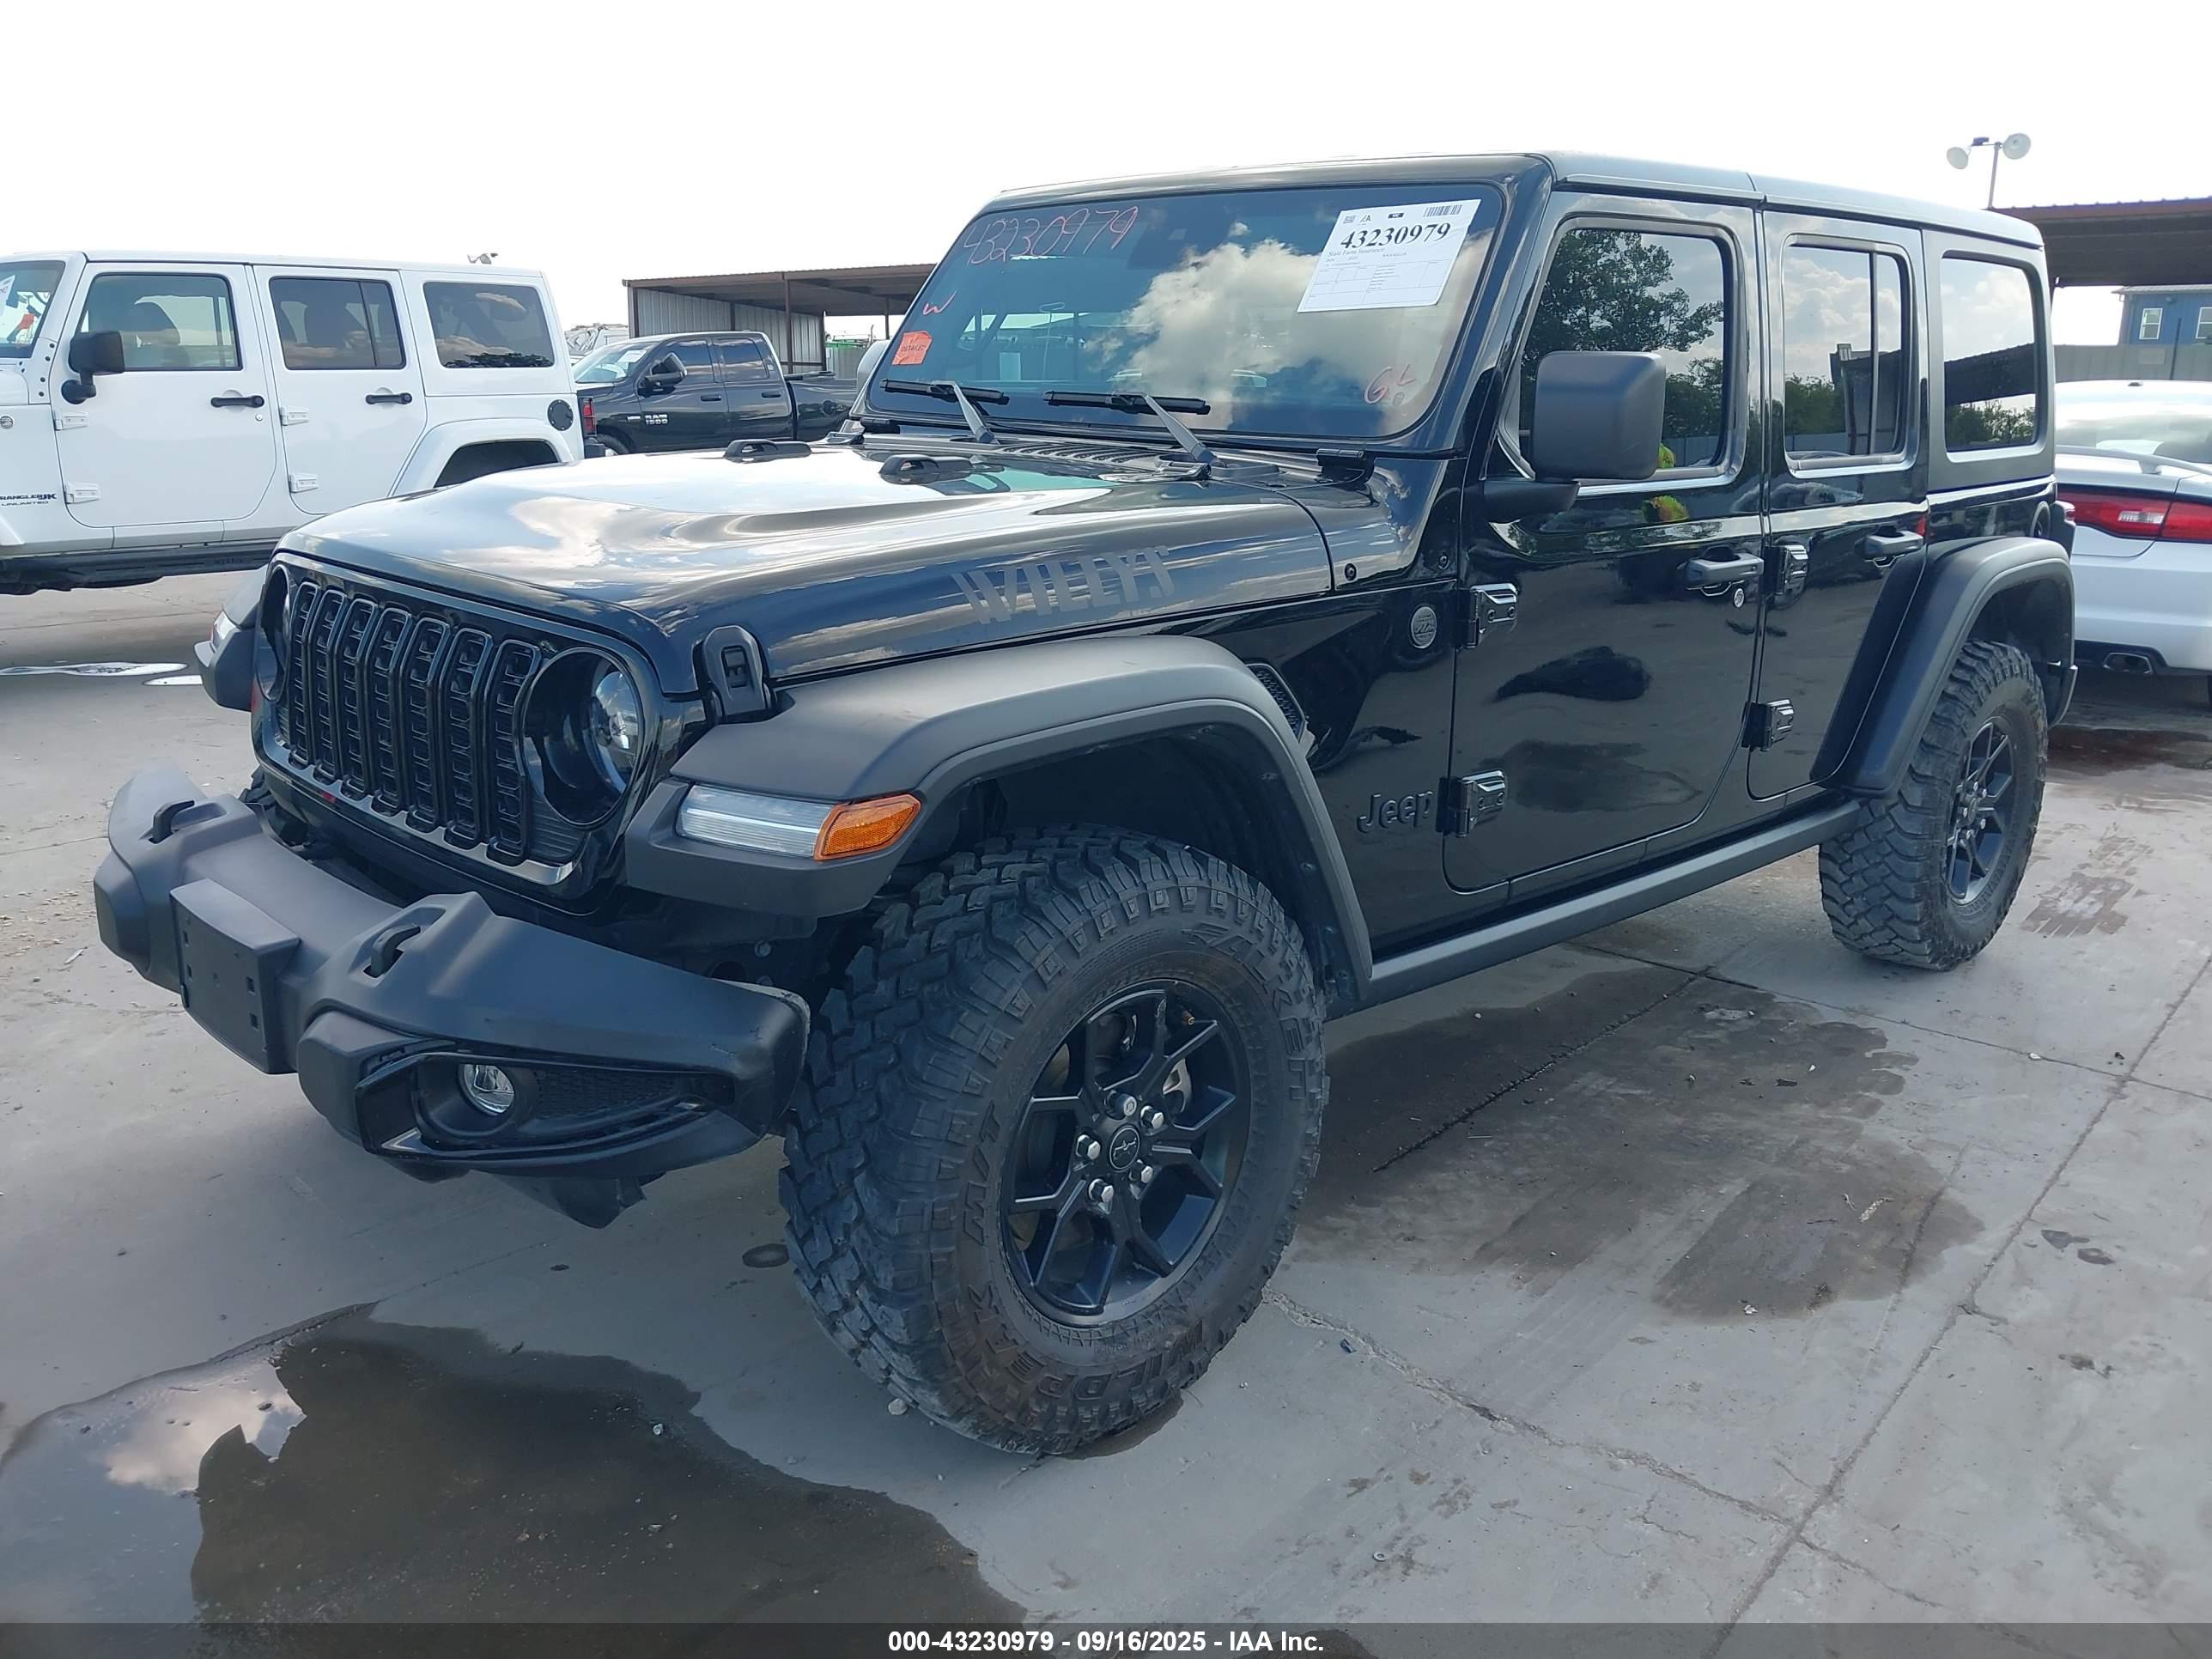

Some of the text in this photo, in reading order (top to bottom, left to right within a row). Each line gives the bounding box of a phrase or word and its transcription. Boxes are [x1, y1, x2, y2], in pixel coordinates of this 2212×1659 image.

[963, 205, 1138, 265] 43230979
[1340, 222, 1451, 249] 43230979
[1356, 789, 1434, 834] Jeep
